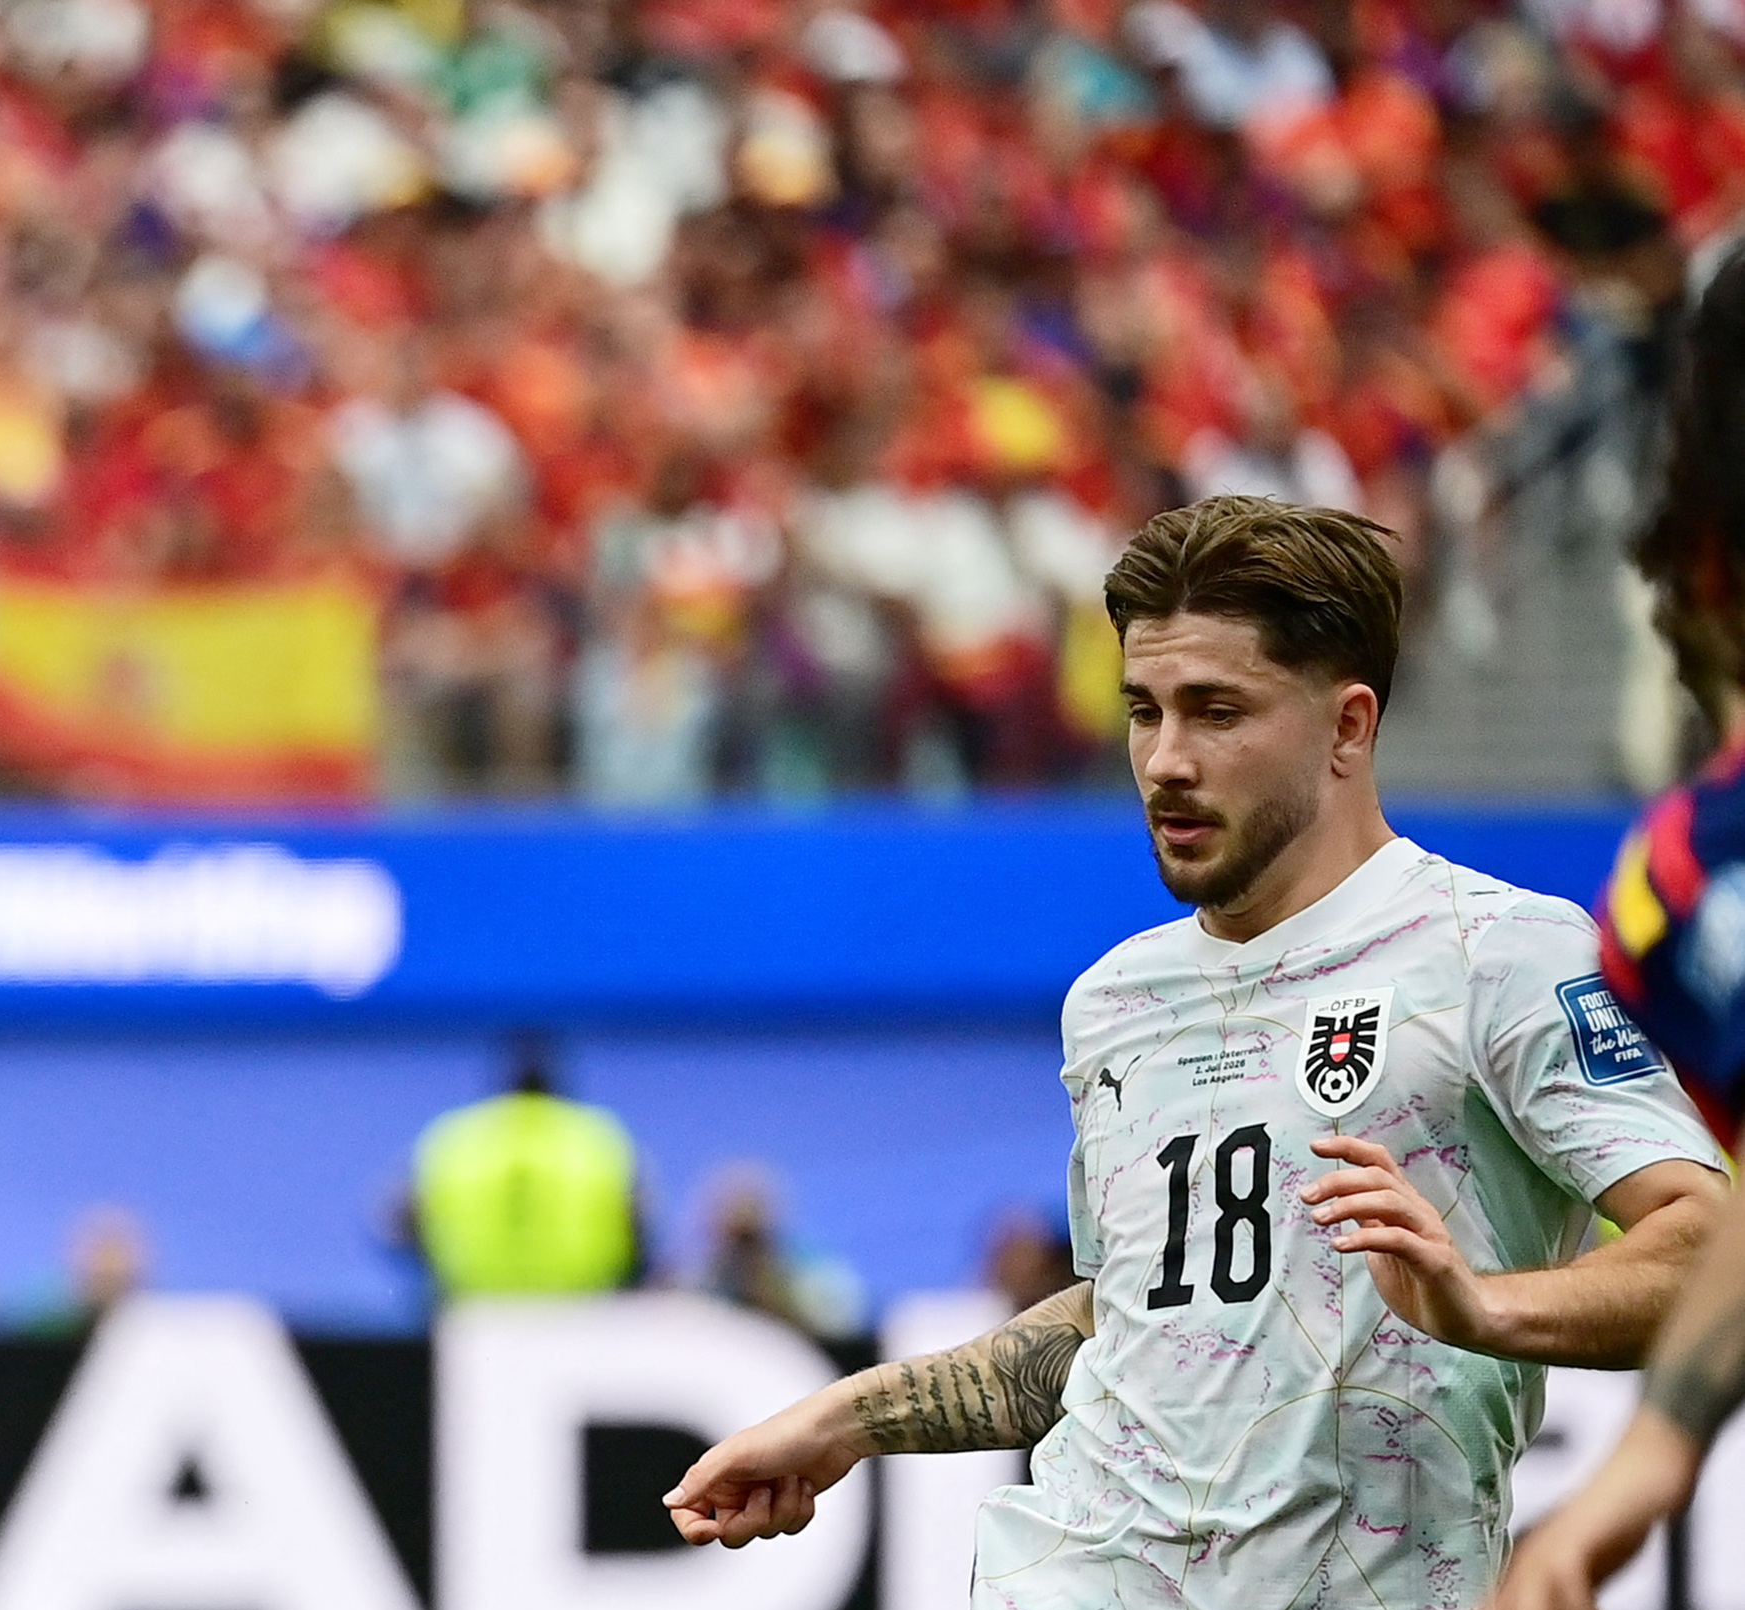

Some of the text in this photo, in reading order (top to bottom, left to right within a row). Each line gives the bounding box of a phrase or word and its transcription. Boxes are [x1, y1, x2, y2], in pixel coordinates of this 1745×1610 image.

[1589, 1033, 1616, 1055] the
[1177, 1053, 1213, 1066] Spanien
[1614, 1047, 1644, 1063] FIFA
[1204, 1062, 1221, 1073] Juli
[1223, 1059, 1246, 1071] 2026
[1192, 1072, 1244, 1087] Los Angeles
[1146, 1121, 1273, 1311] 18
